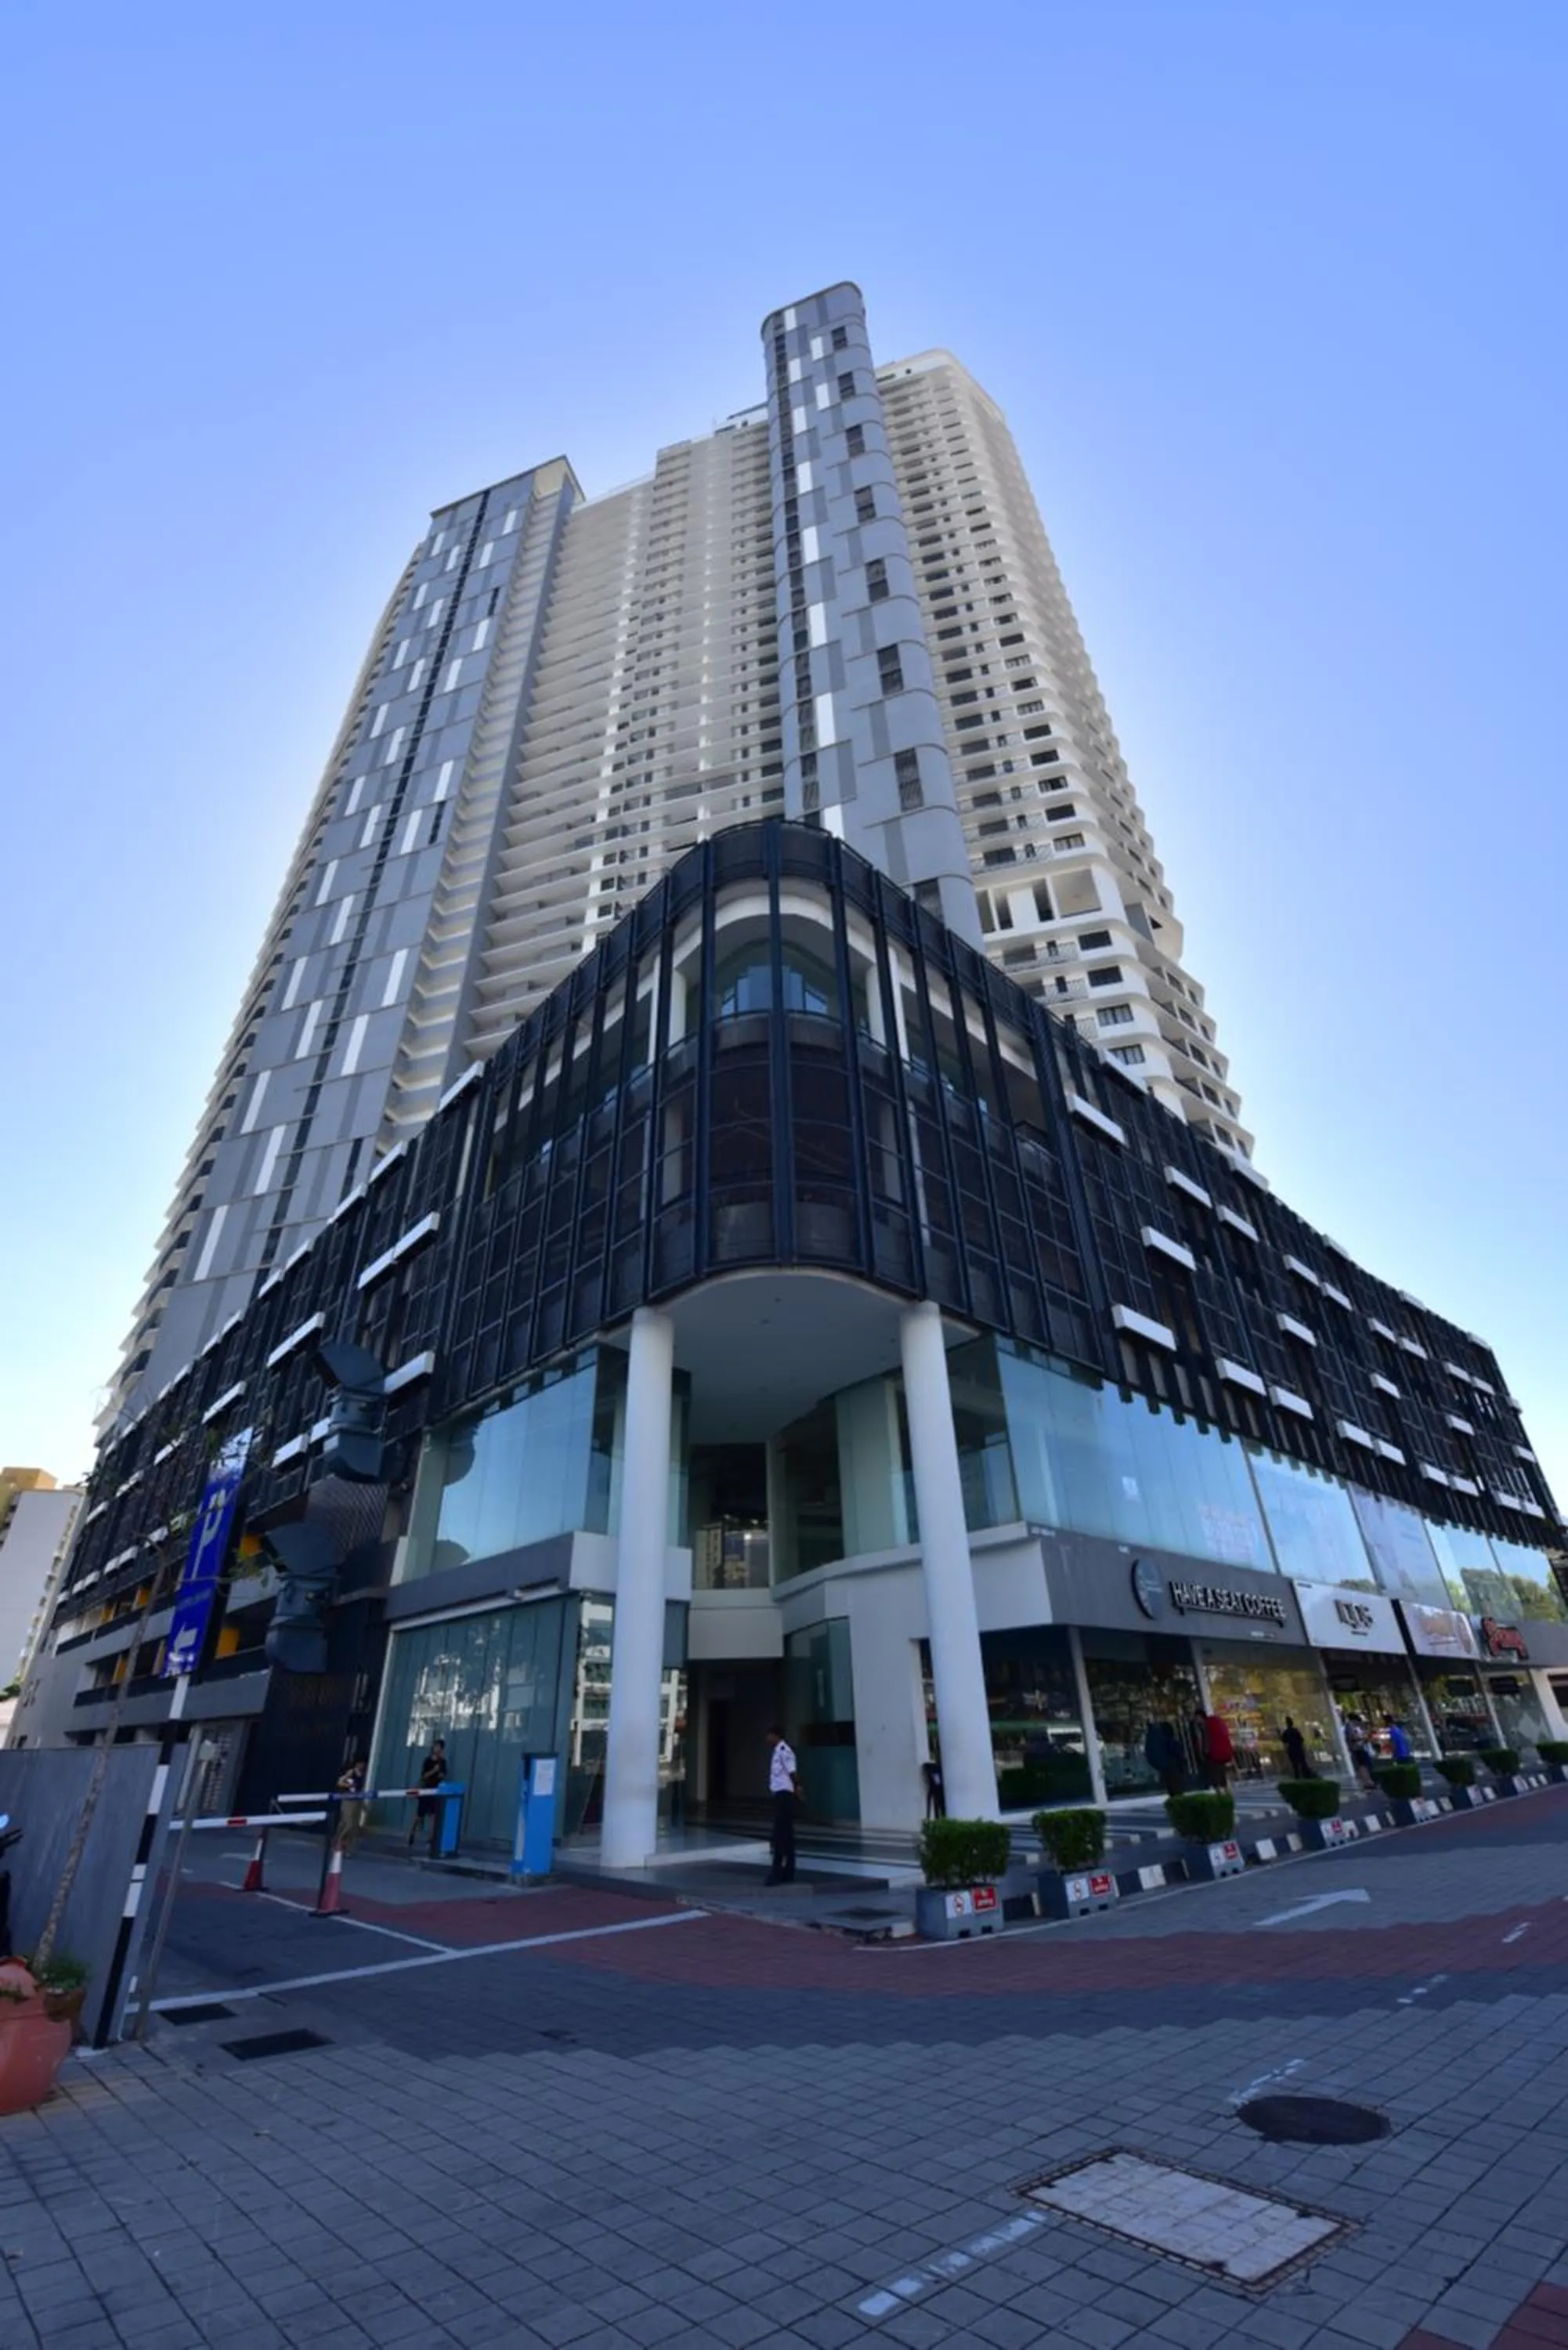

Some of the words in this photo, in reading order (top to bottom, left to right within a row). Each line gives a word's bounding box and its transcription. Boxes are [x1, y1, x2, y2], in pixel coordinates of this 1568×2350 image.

[191, 1489, 226, 1580] P
[1171, 1579, 1206, 1607] HAVE
[1214, 1589, 1245, 1612] SEAT
[1244, 1593, 1286, 1618] COFFEE
